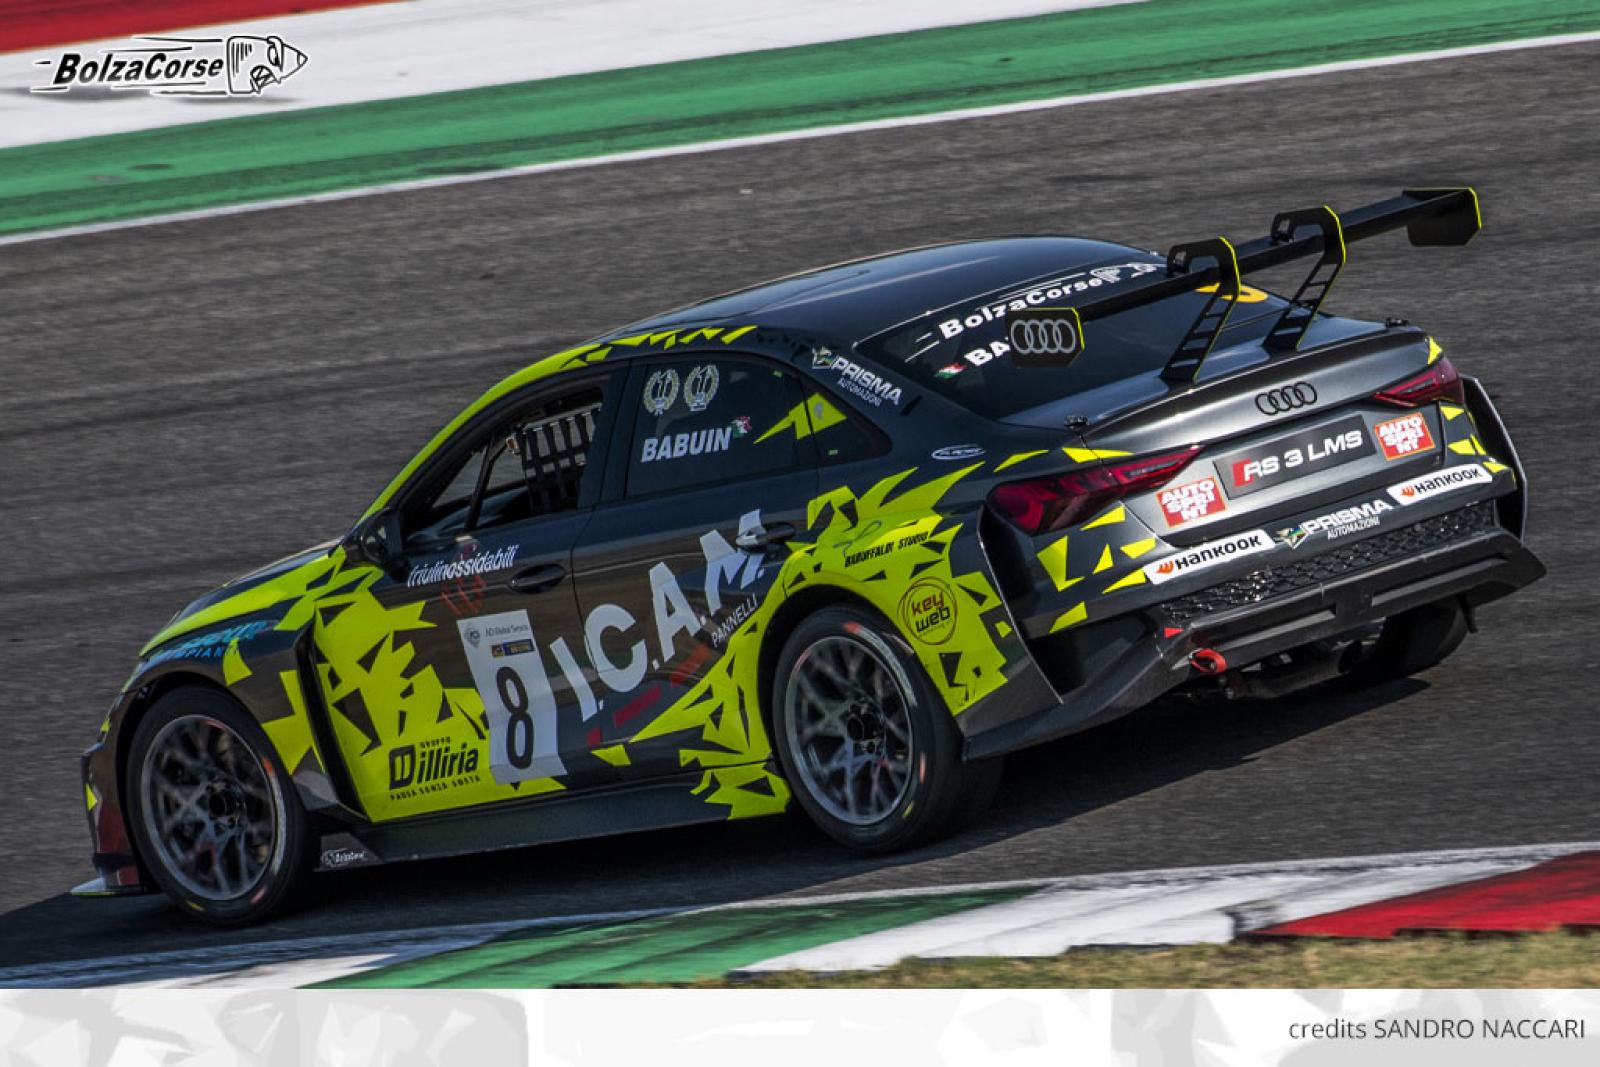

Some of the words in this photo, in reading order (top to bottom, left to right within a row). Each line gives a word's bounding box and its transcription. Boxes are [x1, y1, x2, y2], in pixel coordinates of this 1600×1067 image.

[938, 277, 1103, 340] BolzaCorse
[831, 355, 903, 406] PRISMA
[641, 426, 732, 463] BABUIN
[1378, 416, 1423, 438] AUTO
[1243, 455, 1280, 482] RS
[1284, 448, 1303, 467] 3
[1309, 430, 1363, 459] LMS
[1161, 480, 1215, 505] AUTO
[1301, 499, 1394, 535] PRISMA
[711, 592, 758, 648] PANNELLI
[911, 590, 945, 617] key
[915, 607, 951, 632] web
[496, 665, 535, 770] 8
